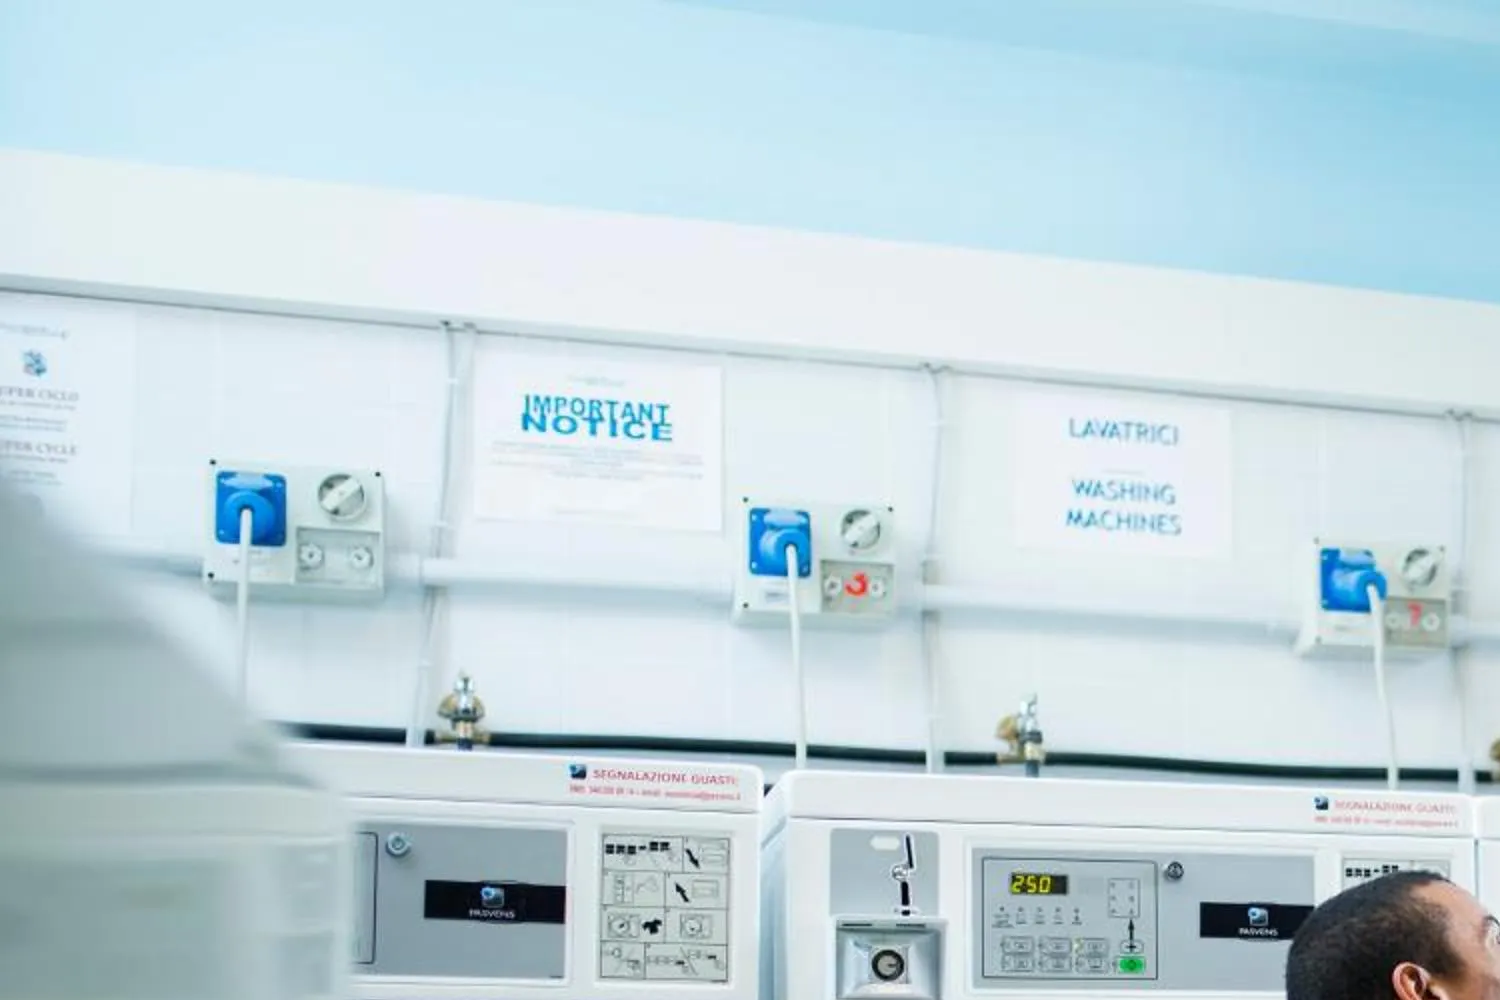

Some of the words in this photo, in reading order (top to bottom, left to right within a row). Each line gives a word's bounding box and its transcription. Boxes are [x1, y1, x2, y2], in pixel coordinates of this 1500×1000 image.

[524, 393, 671, 427] IMPORTANT
[521, 411, 673, 441] NOTICE
[1068, 417, 1179, 446] LAVATRICI
[1071, 479, 1176, 506] WASHING
[1065, 508, 1182, 536] MACHINES
[592, 769, 688, 784] SEGNALAZIONE
[1010, 874, 1052, 894] 250
